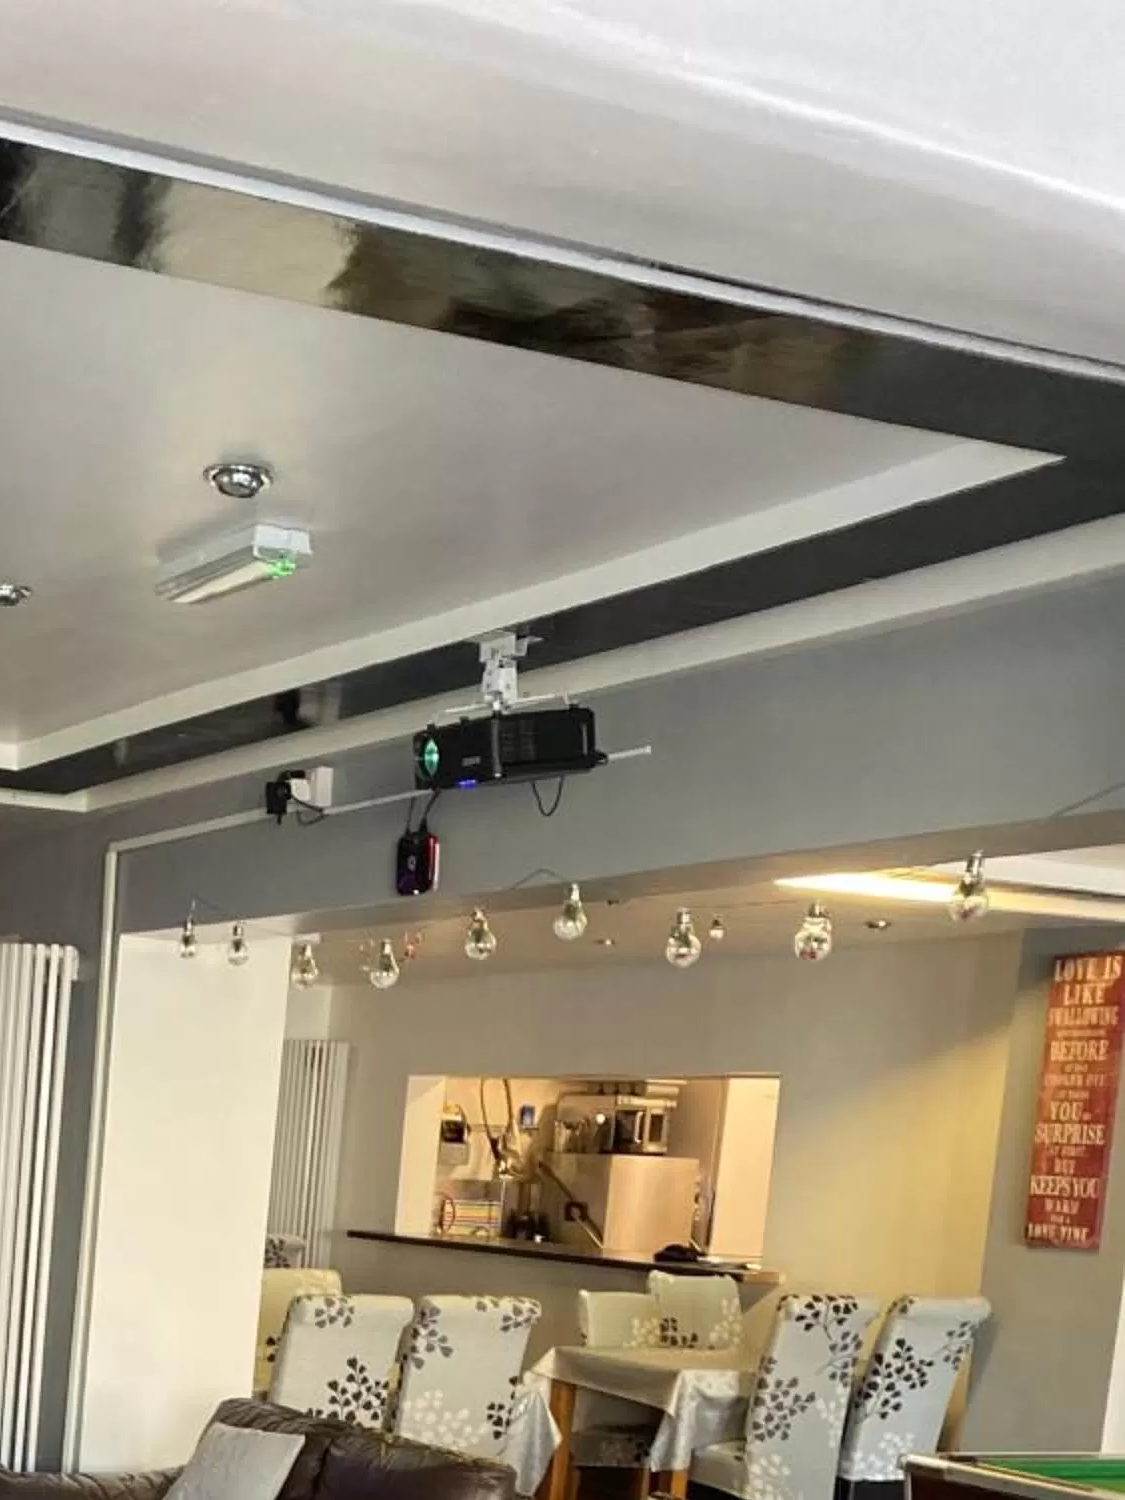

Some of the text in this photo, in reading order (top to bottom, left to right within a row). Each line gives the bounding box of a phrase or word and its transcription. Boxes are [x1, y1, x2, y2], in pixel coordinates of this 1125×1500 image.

[1063, 982, 1105, 1005] LIKE
[1050, 1039, 1109, 1061] BEFORE
[1050, 1101, 1083, 1121] YOU
[1035, 1121, 1106, 1145] SURPRISE
[1030, 1175, 1100, 1199] KEEPS YOU
